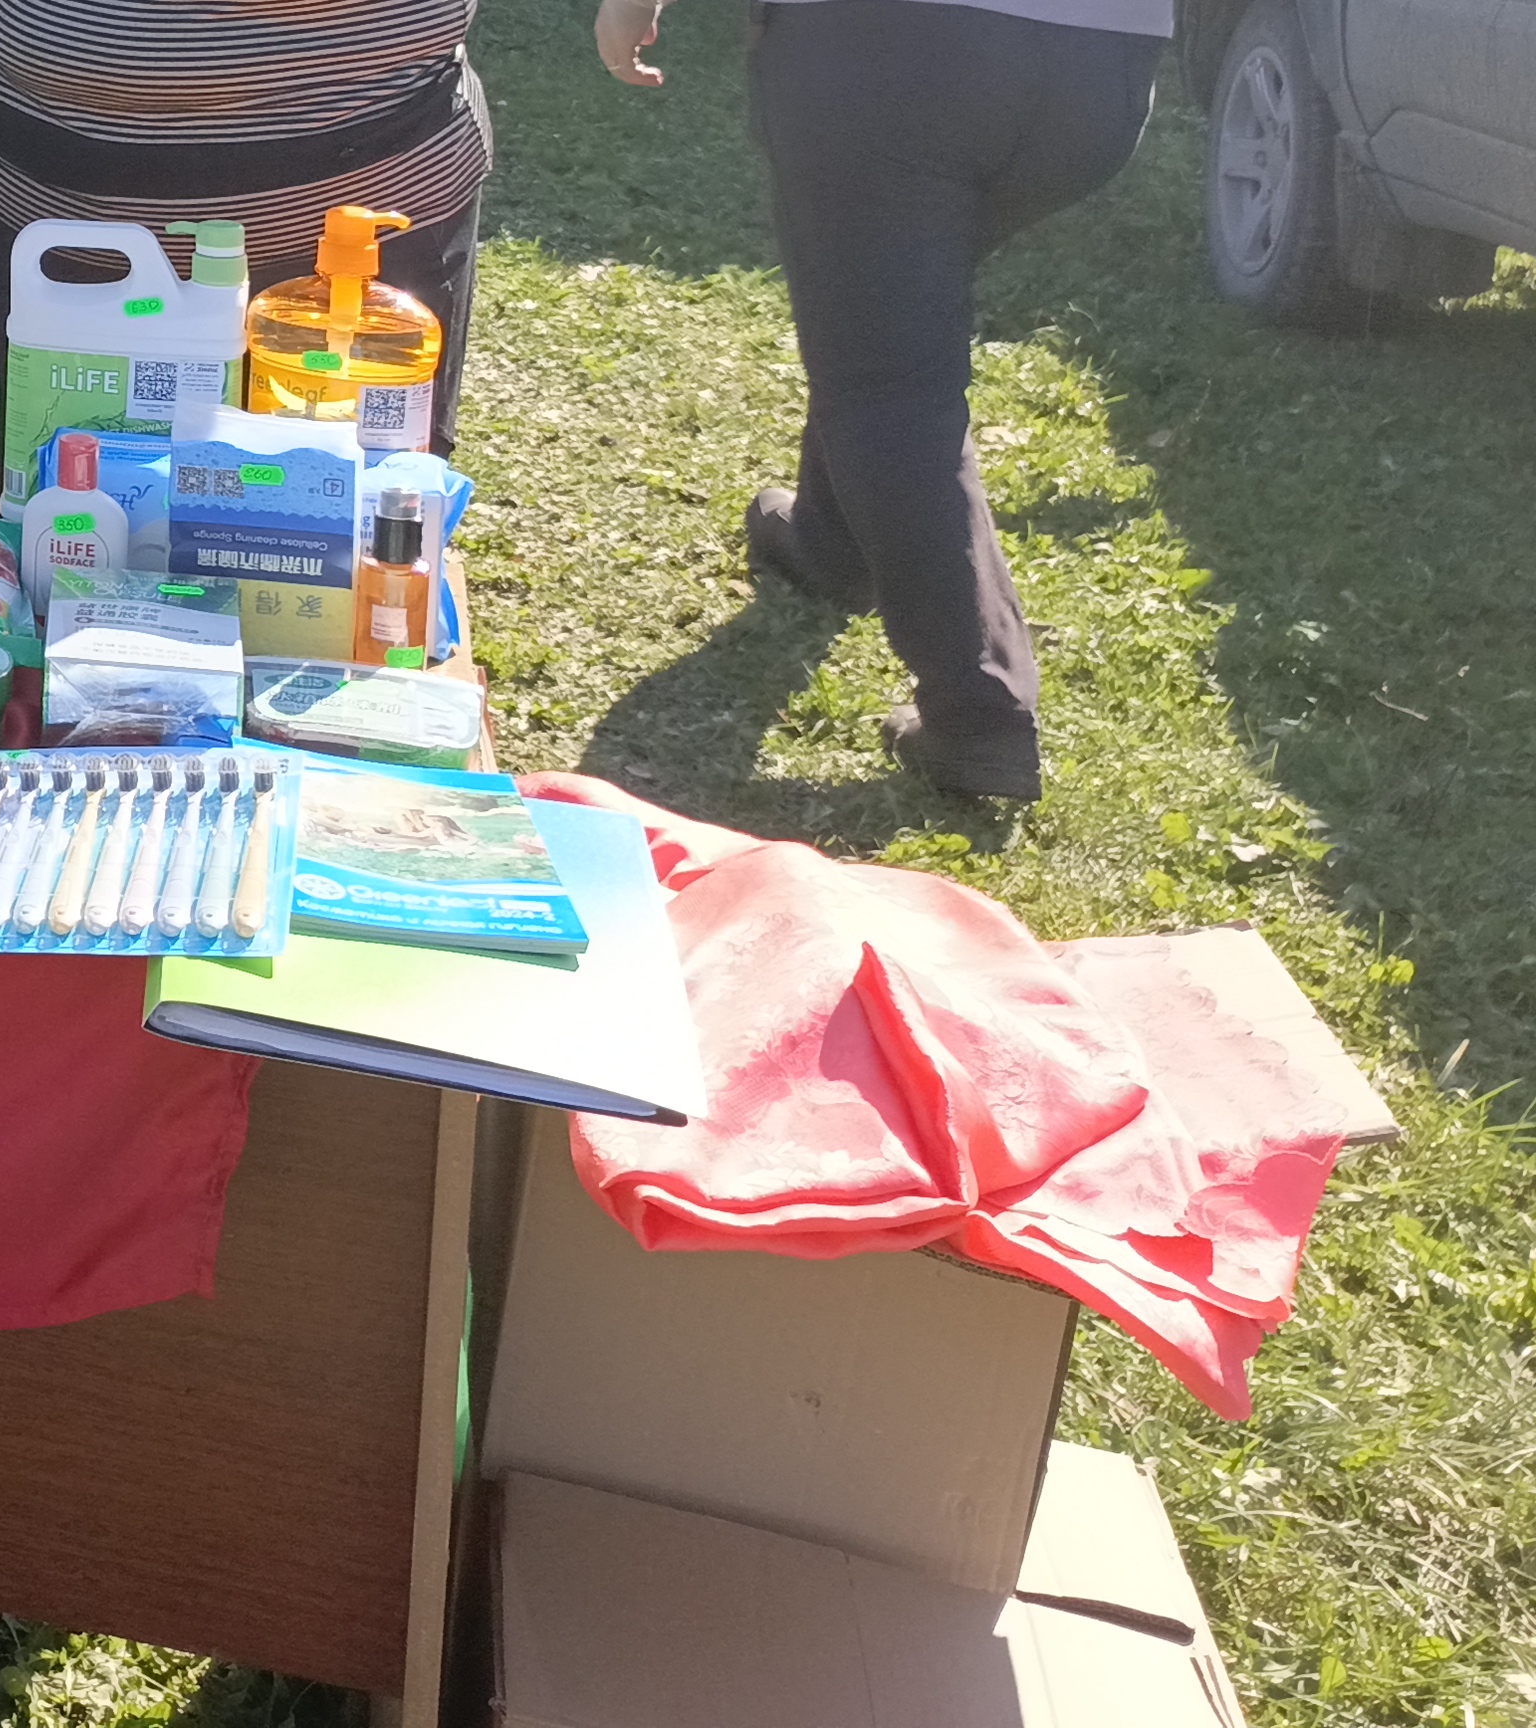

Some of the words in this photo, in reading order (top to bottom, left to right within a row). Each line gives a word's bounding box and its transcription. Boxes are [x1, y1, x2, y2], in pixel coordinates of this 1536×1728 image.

[50, 364, 121, 395] iLiFE
[57, 517, 84, 531] 350
[193, 529, 232, 542] Sponge
[235, 532, 278, 546] cleaning
[50, 538, 96, 558] iLiFE
